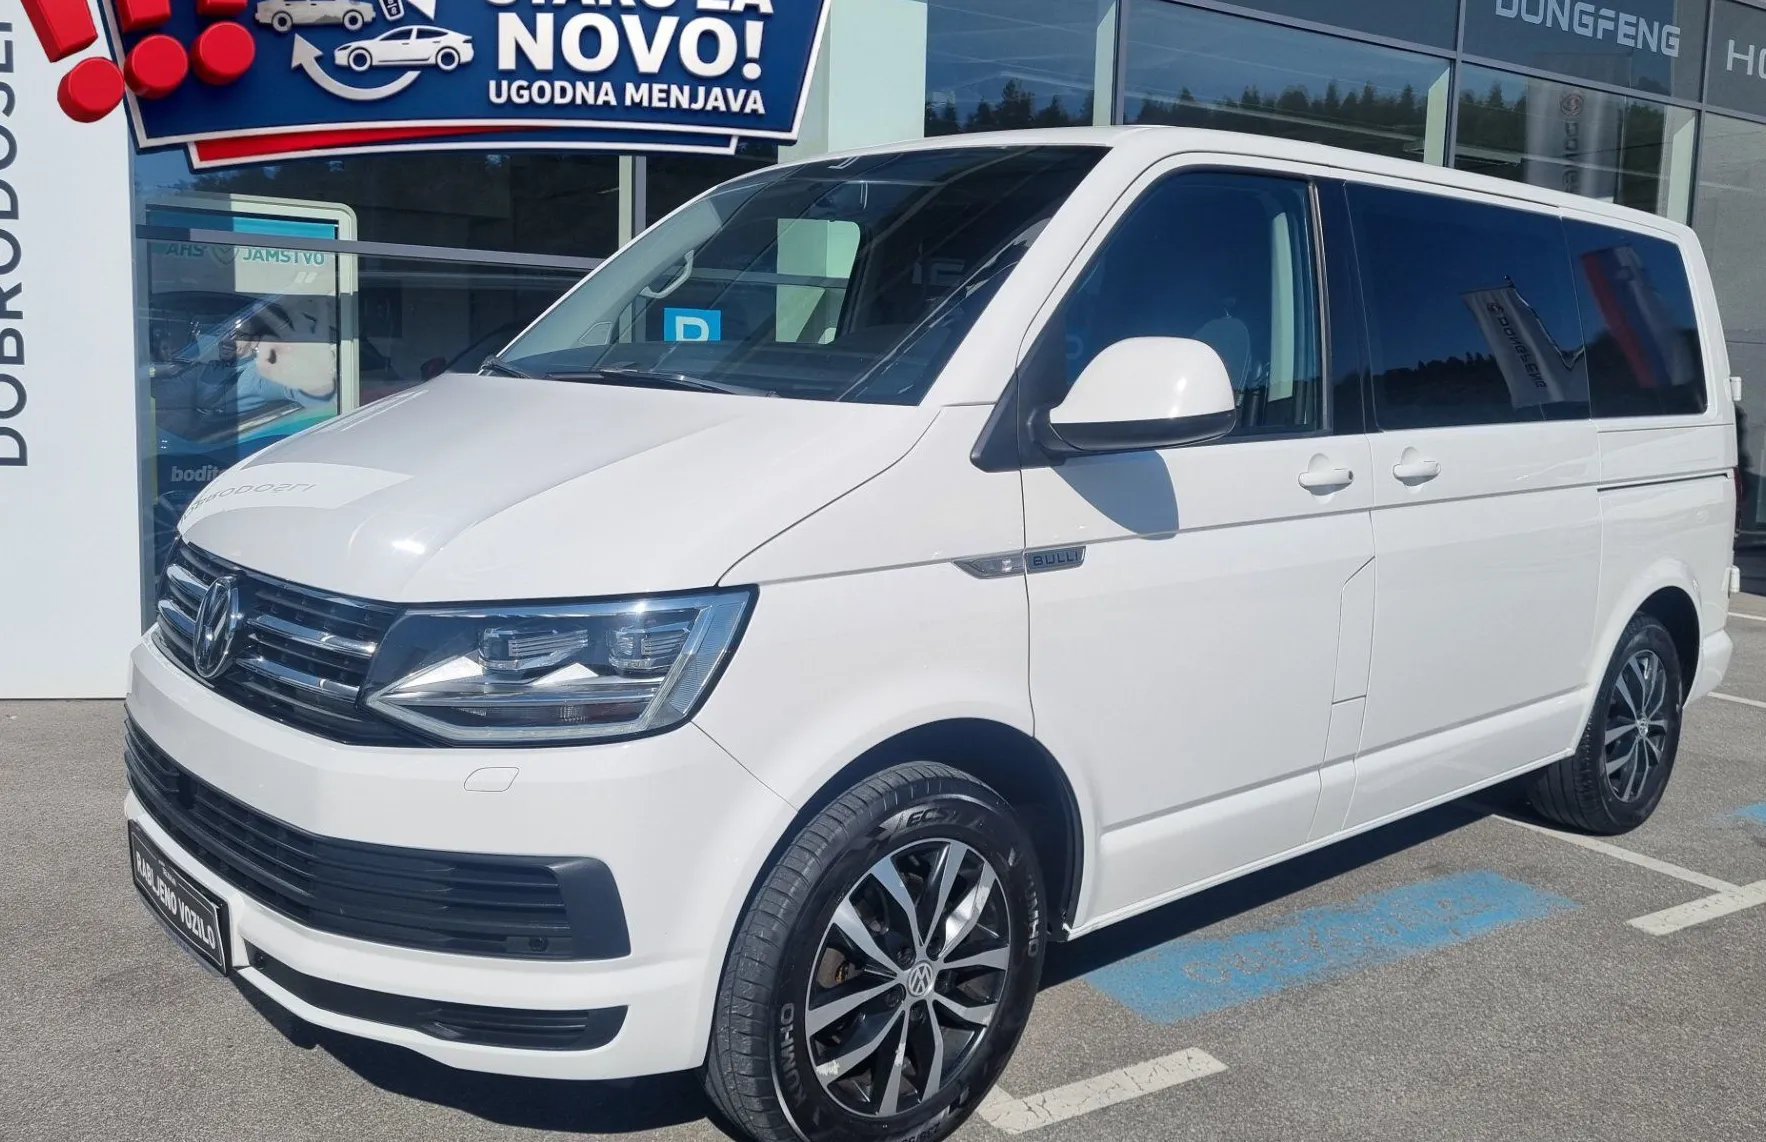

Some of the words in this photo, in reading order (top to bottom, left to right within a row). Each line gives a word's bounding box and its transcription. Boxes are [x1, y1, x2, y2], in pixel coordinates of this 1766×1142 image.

[1495, 0, 1681, 58] DONGFENG
[1726, 39, 1766, 80] H
[171, 465, 228, 482] bodit
[1033, 551, 1079, 567] BULLI
[135, 851, 178, 916] RABLJENO
[178, 897, 217, 950] VOZILO
